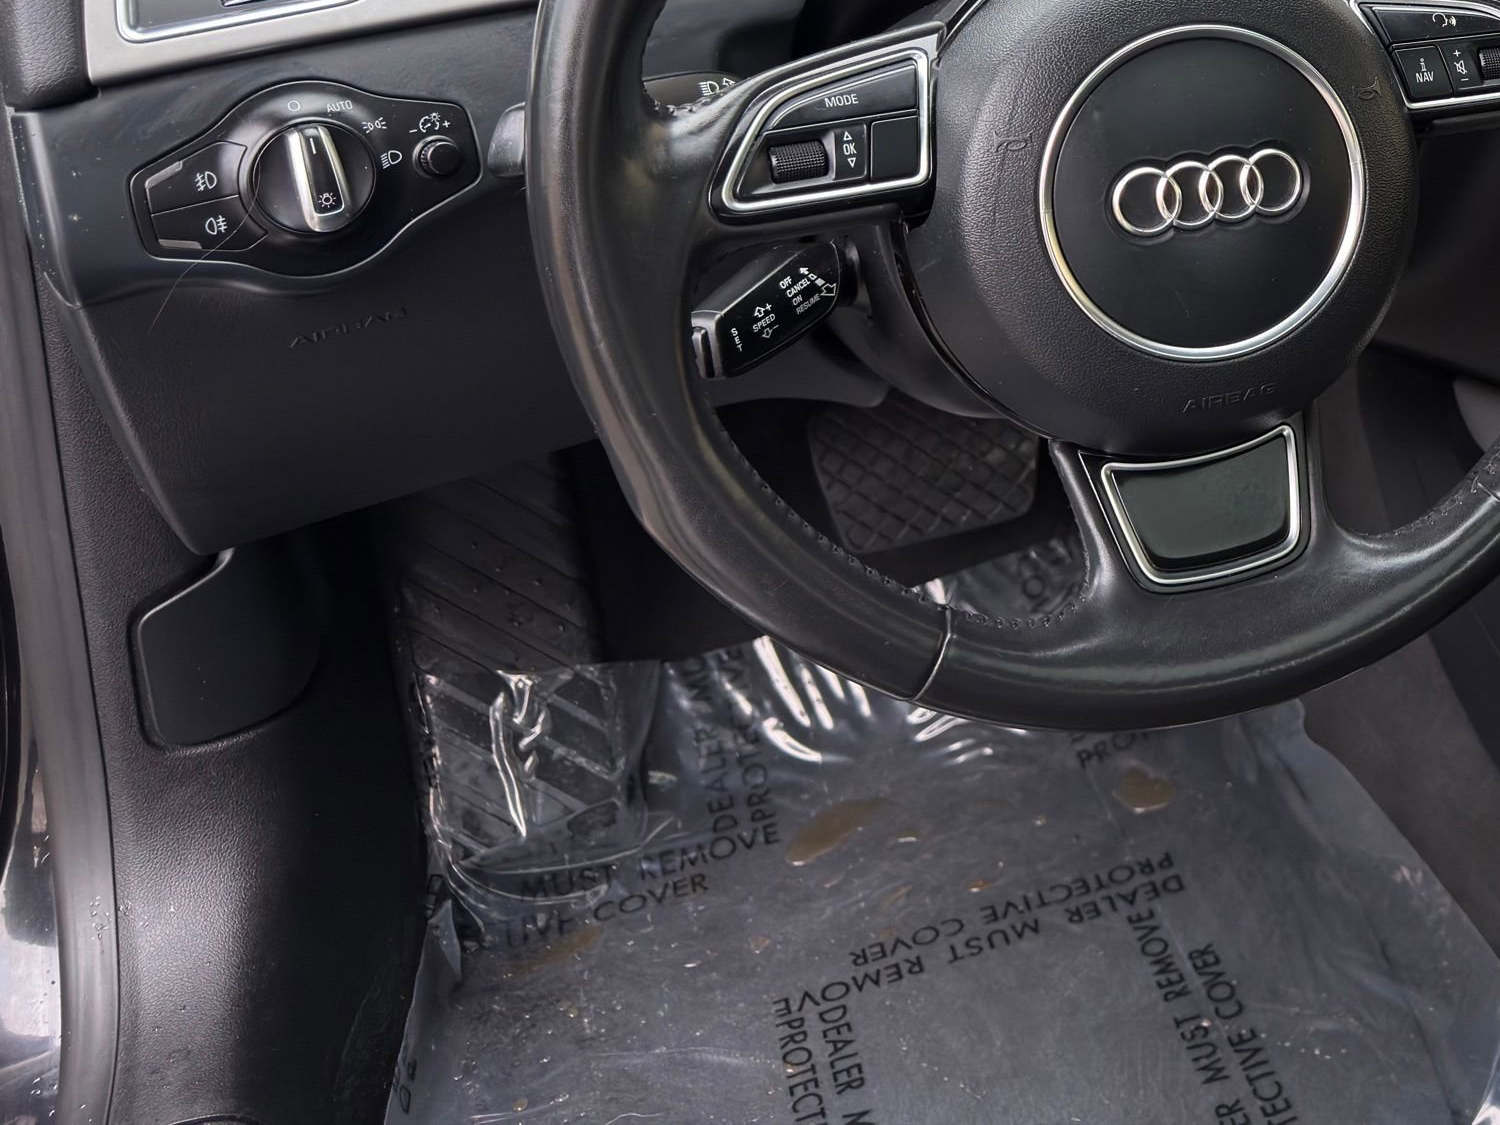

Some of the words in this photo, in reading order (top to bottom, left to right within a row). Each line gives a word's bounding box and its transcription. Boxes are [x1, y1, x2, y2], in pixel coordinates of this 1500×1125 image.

[824, 93, 859, 109] MODE
[1415, 71, 1434, 84] NAV
[326, 100, 354, 113] AUTO
[843, 142, 857, 156] OK
[779, 275, 794, 290] OFF
[786, 277, 811, 298] CANCEL
[792, 294, 803, 306] ON
[796, 293, 821, 315] RESUME
[752, 313, 776, 333] SPEED
[640, 822, 782, 881] REMOVE
[593, 873, 710, 923] COVER
[980, 851, 1176, 926] PROTECTIVE
[1065, 873, 1187, 925] DEALER
[849, 917, 966, 968] COVER
[946, 917, 1041, 966] MUST
[1126, 906, 1194, 1004] REMOVE
[772, 955, 926, 1019] REMOVE
[1187, 941, 1247, 1023] COVER
[774, 1011, 829, 1125] PROTECT
[818, 1002, 867, 1096] DEALER
[1172, 1012, 1232, 1087] MUST
[1226, 1025, 1300, 1125] TECTIVE
